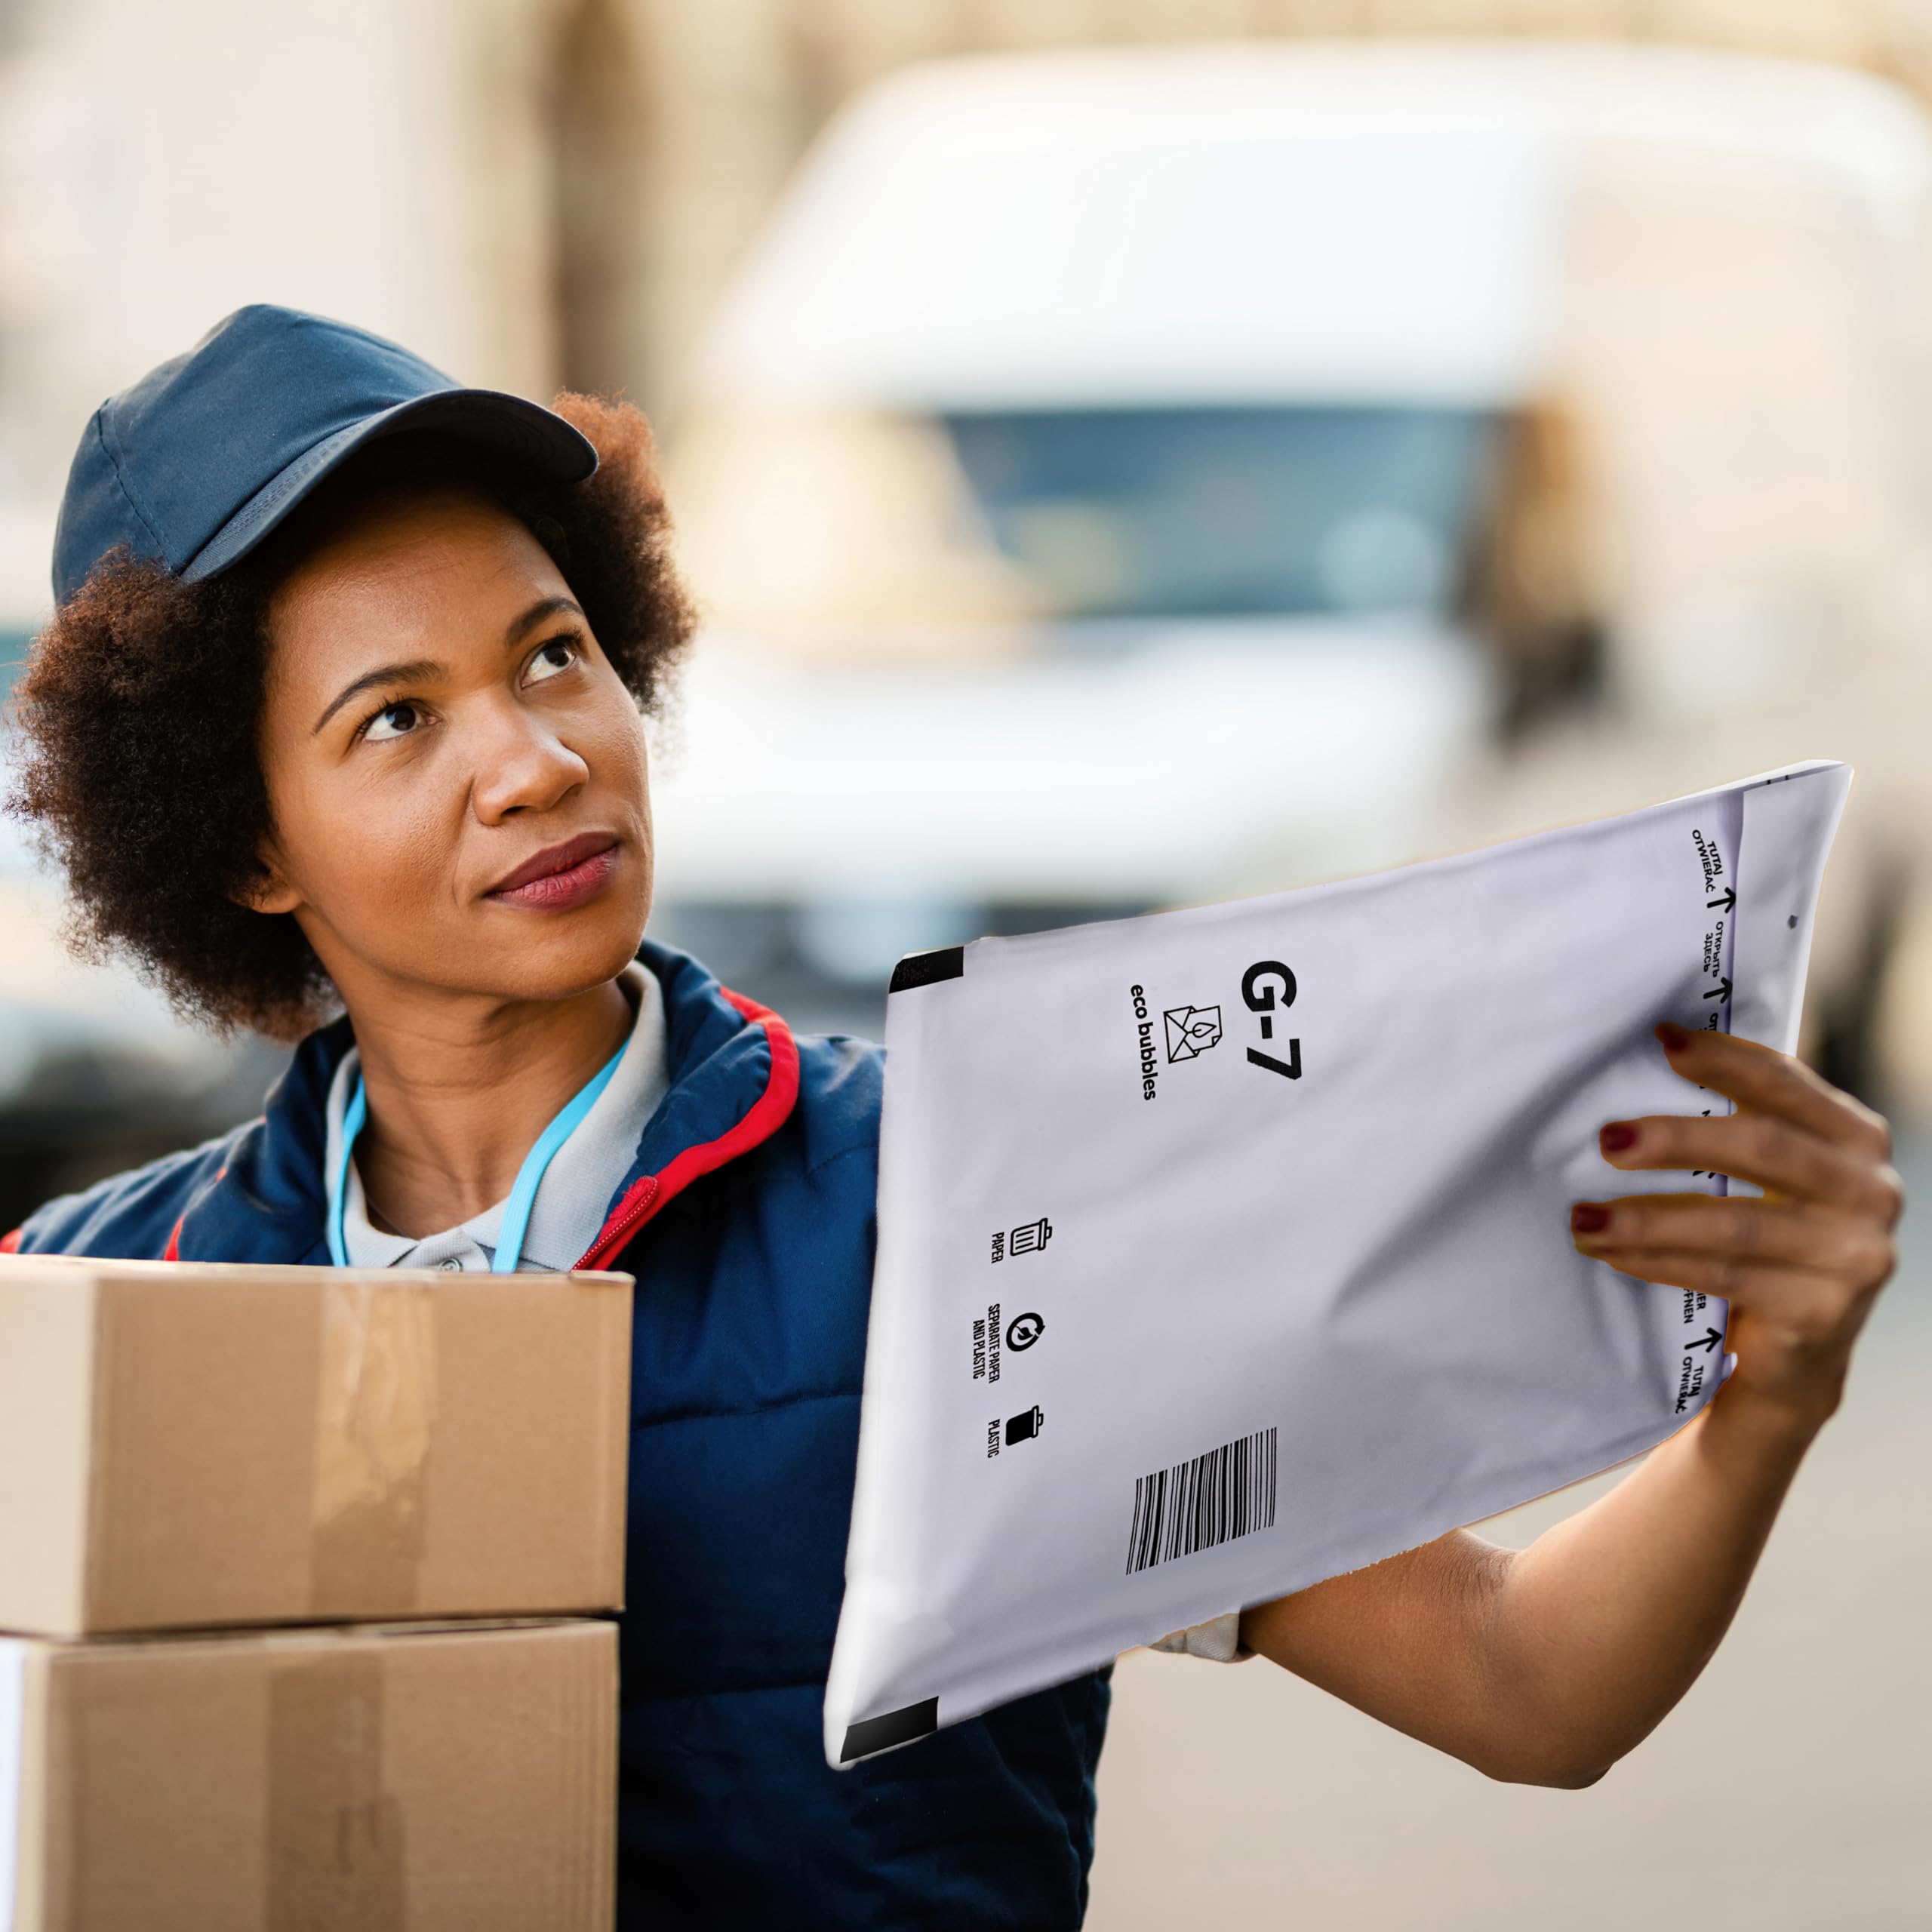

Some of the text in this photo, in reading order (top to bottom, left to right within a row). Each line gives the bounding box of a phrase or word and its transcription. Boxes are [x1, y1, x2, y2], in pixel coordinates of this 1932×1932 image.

[1692, 829, 1716, 894] OTWIERAĆ
[1707, 840, 1723, 875] TUTAJ
[1703, 932, 1713, 973] ЗДЕСЬ
[1712, 921, 1724, 978] ОТКРЫТЬ
[1131, 984, 1158, 1101] eco bubbles
[1241, 960, 1302, 1081] G-7
[991, 1232, 1004, 1264] PAPER
[1696, 1291, 1706, 1311] IER
[973, 1319, 986, 1380] AND PLASTIC
[988, 1303, 1001, 1384] SEPARATE PAPER
[1687, 1365, 1703, 1398] TUTAJ
[987, 1419, 1001, 1459] PLASTIC
